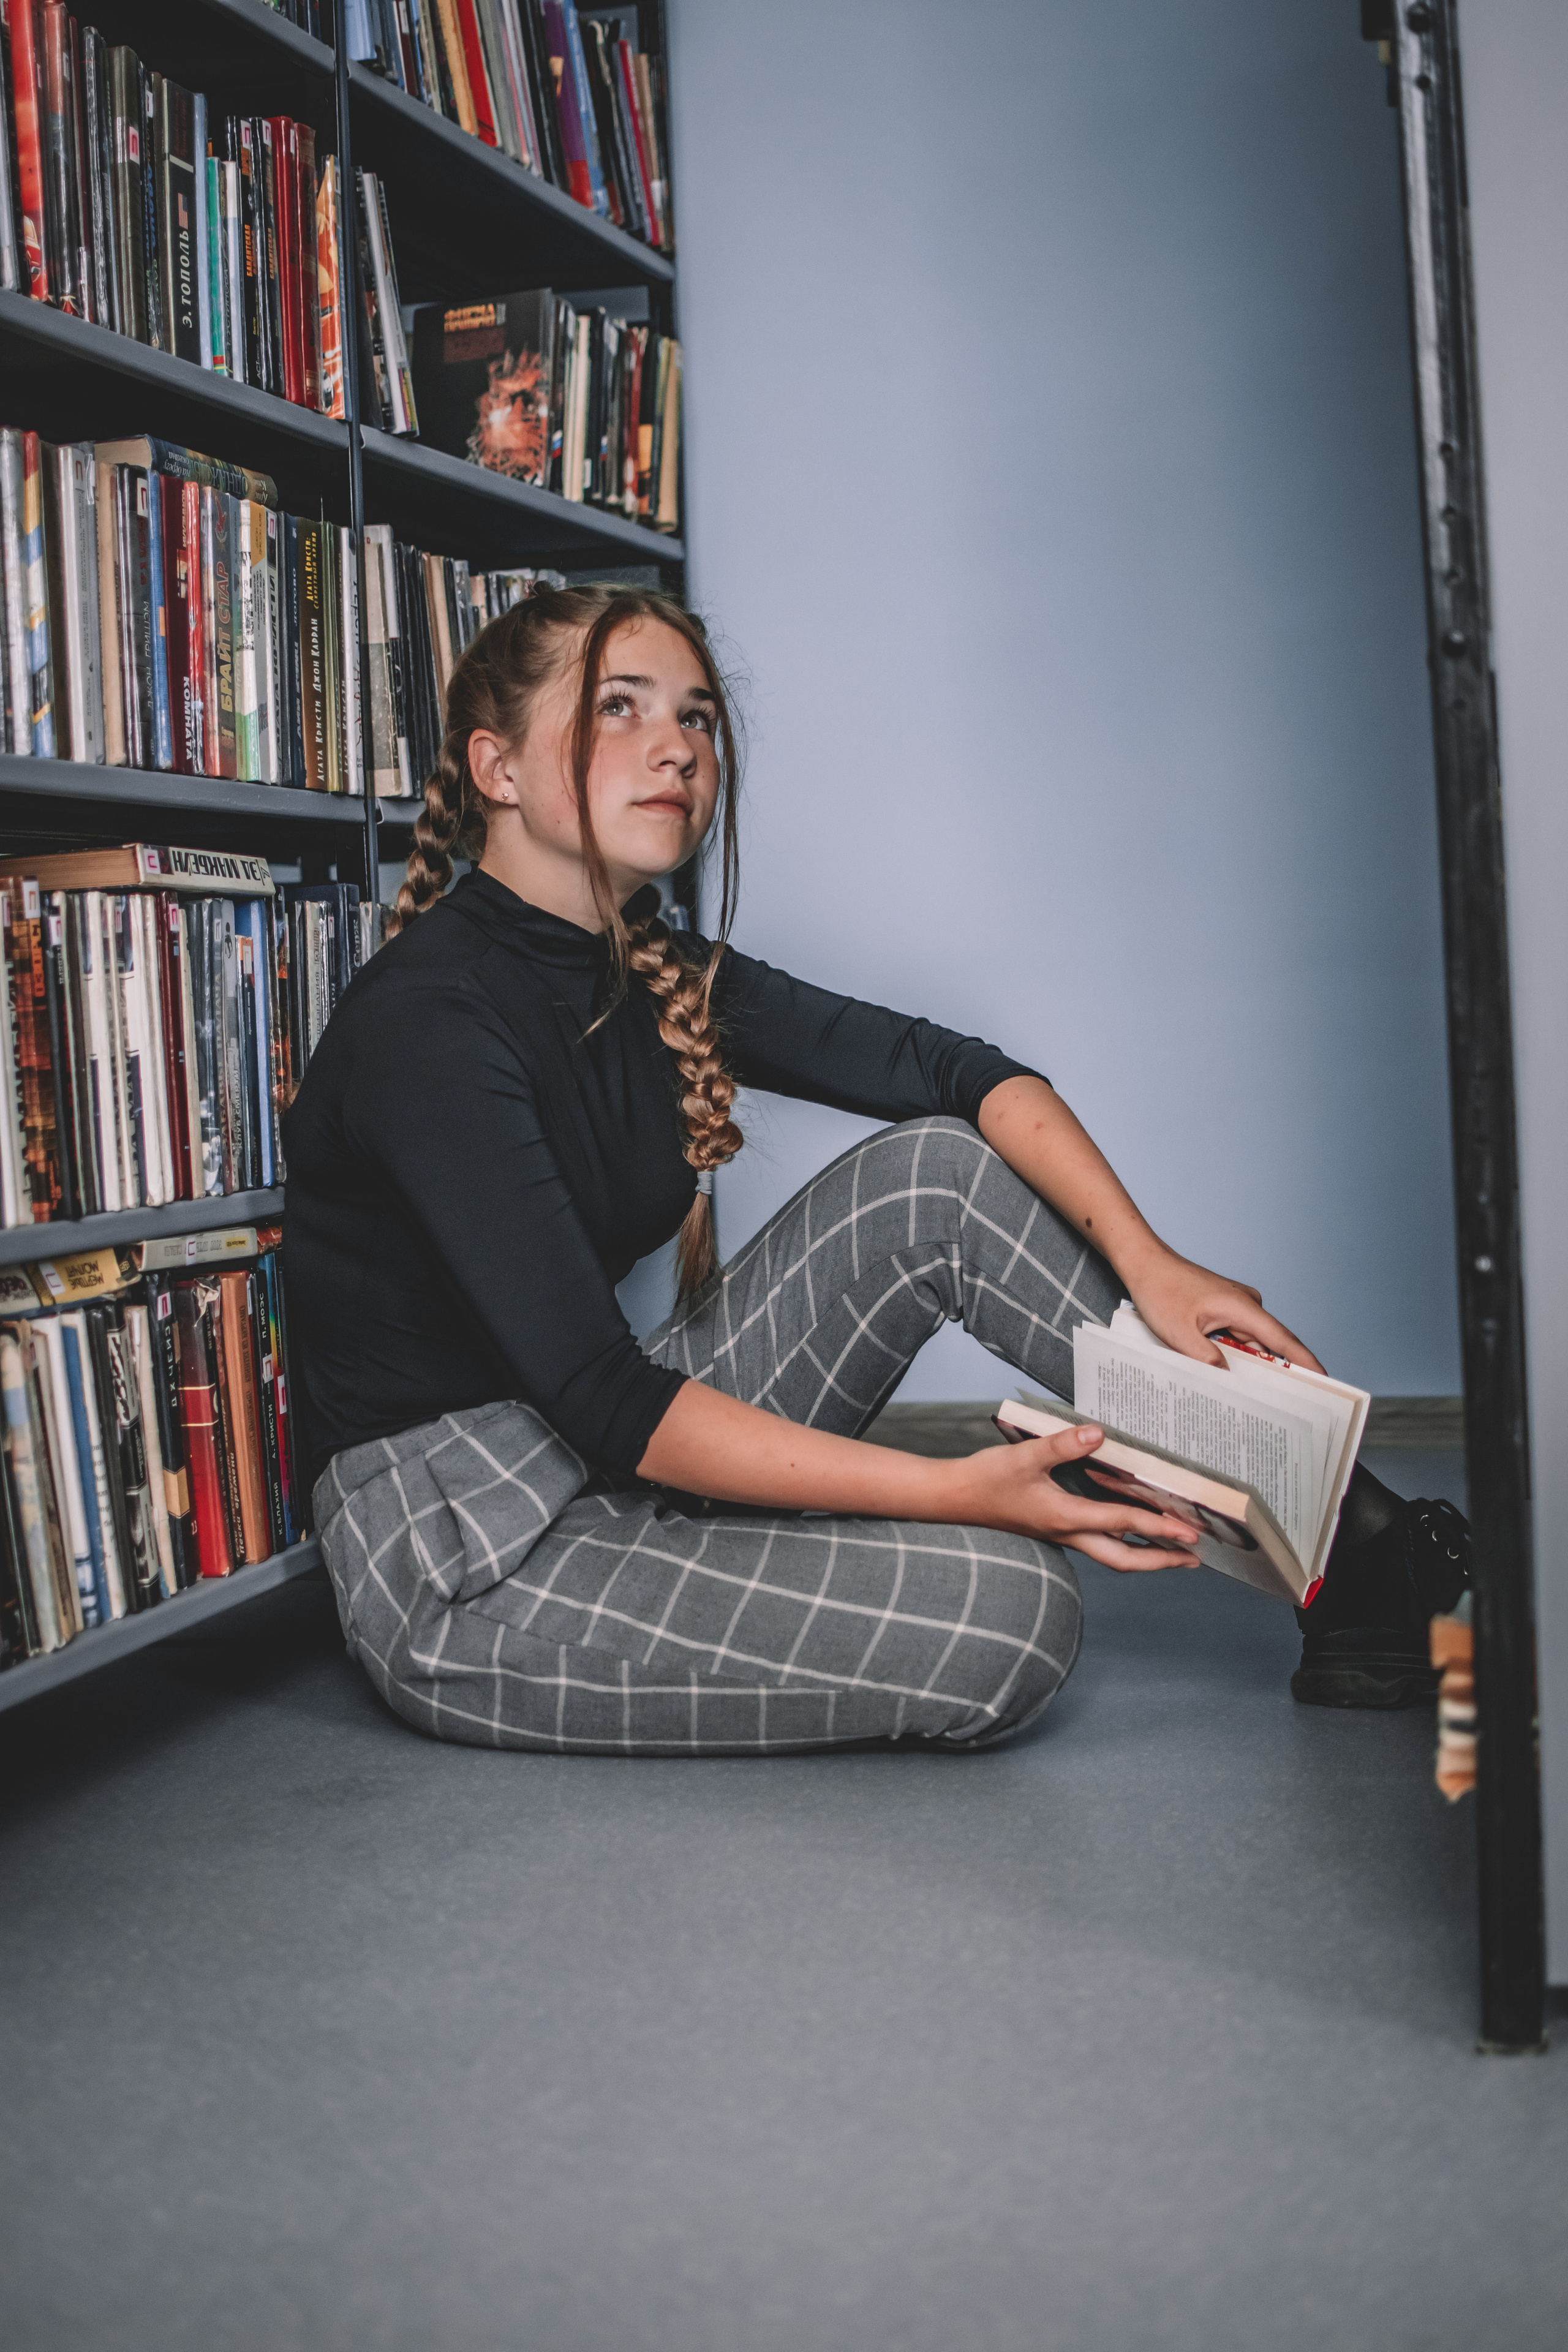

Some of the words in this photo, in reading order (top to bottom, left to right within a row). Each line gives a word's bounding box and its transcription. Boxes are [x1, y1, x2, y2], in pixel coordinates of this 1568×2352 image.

[179, 230, 192, 306] ТОПОЛЬ
[244, 224, 253, 277] БАНДИТСКАЯ
[183, 311, 192, 328] Э.
[164, 459, 182, 477] берегу
[183, 468, 190, 477] на
[216, 561, 231, 624] СТАР
[143, 601, 151, 657] ГРИШЭМ
[311, 619, 320, 657] КАРРАН
[217, 628, 233, 712] БРАЙТ
[312, 660, 321, 693] ДЖОН
[183, 677, 192, 760] КОМНАТА
[172, 850, 241, 880] МАКБЕЙН
[240, 860, 261, 881] ЭД
[217, 1061, 227, 1146] ЗАБАВЫ
[66, 1260, 99, 1277] МОЛЧАТ
[72, 1272, 105, 1290] МЕРТВЫЕ
[231, 1452, 239, 1509] времени
